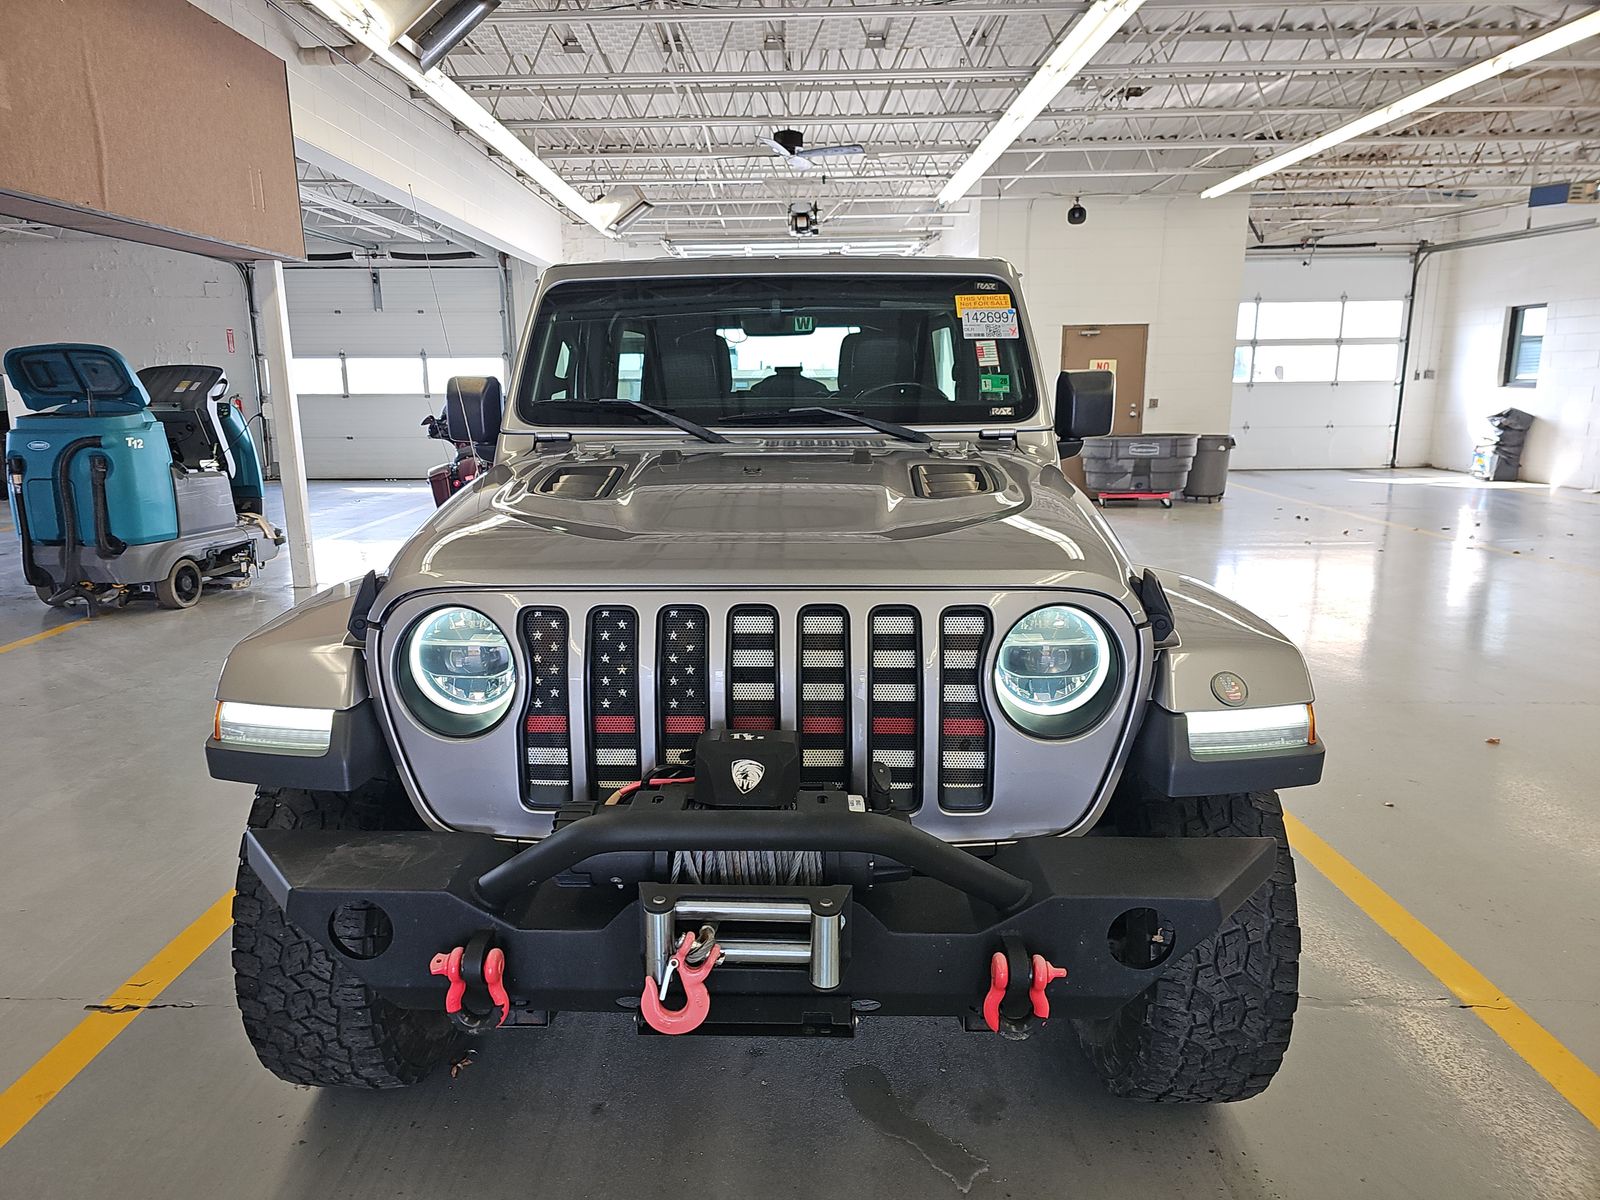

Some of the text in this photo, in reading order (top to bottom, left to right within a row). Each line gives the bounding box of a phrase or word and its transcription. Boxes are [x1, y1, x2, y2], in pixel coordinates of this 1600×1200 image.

[965, 311, 1016, 323] 1426997
[796, 317, 811, 330] W
[125, 437, 144, 449] T12
